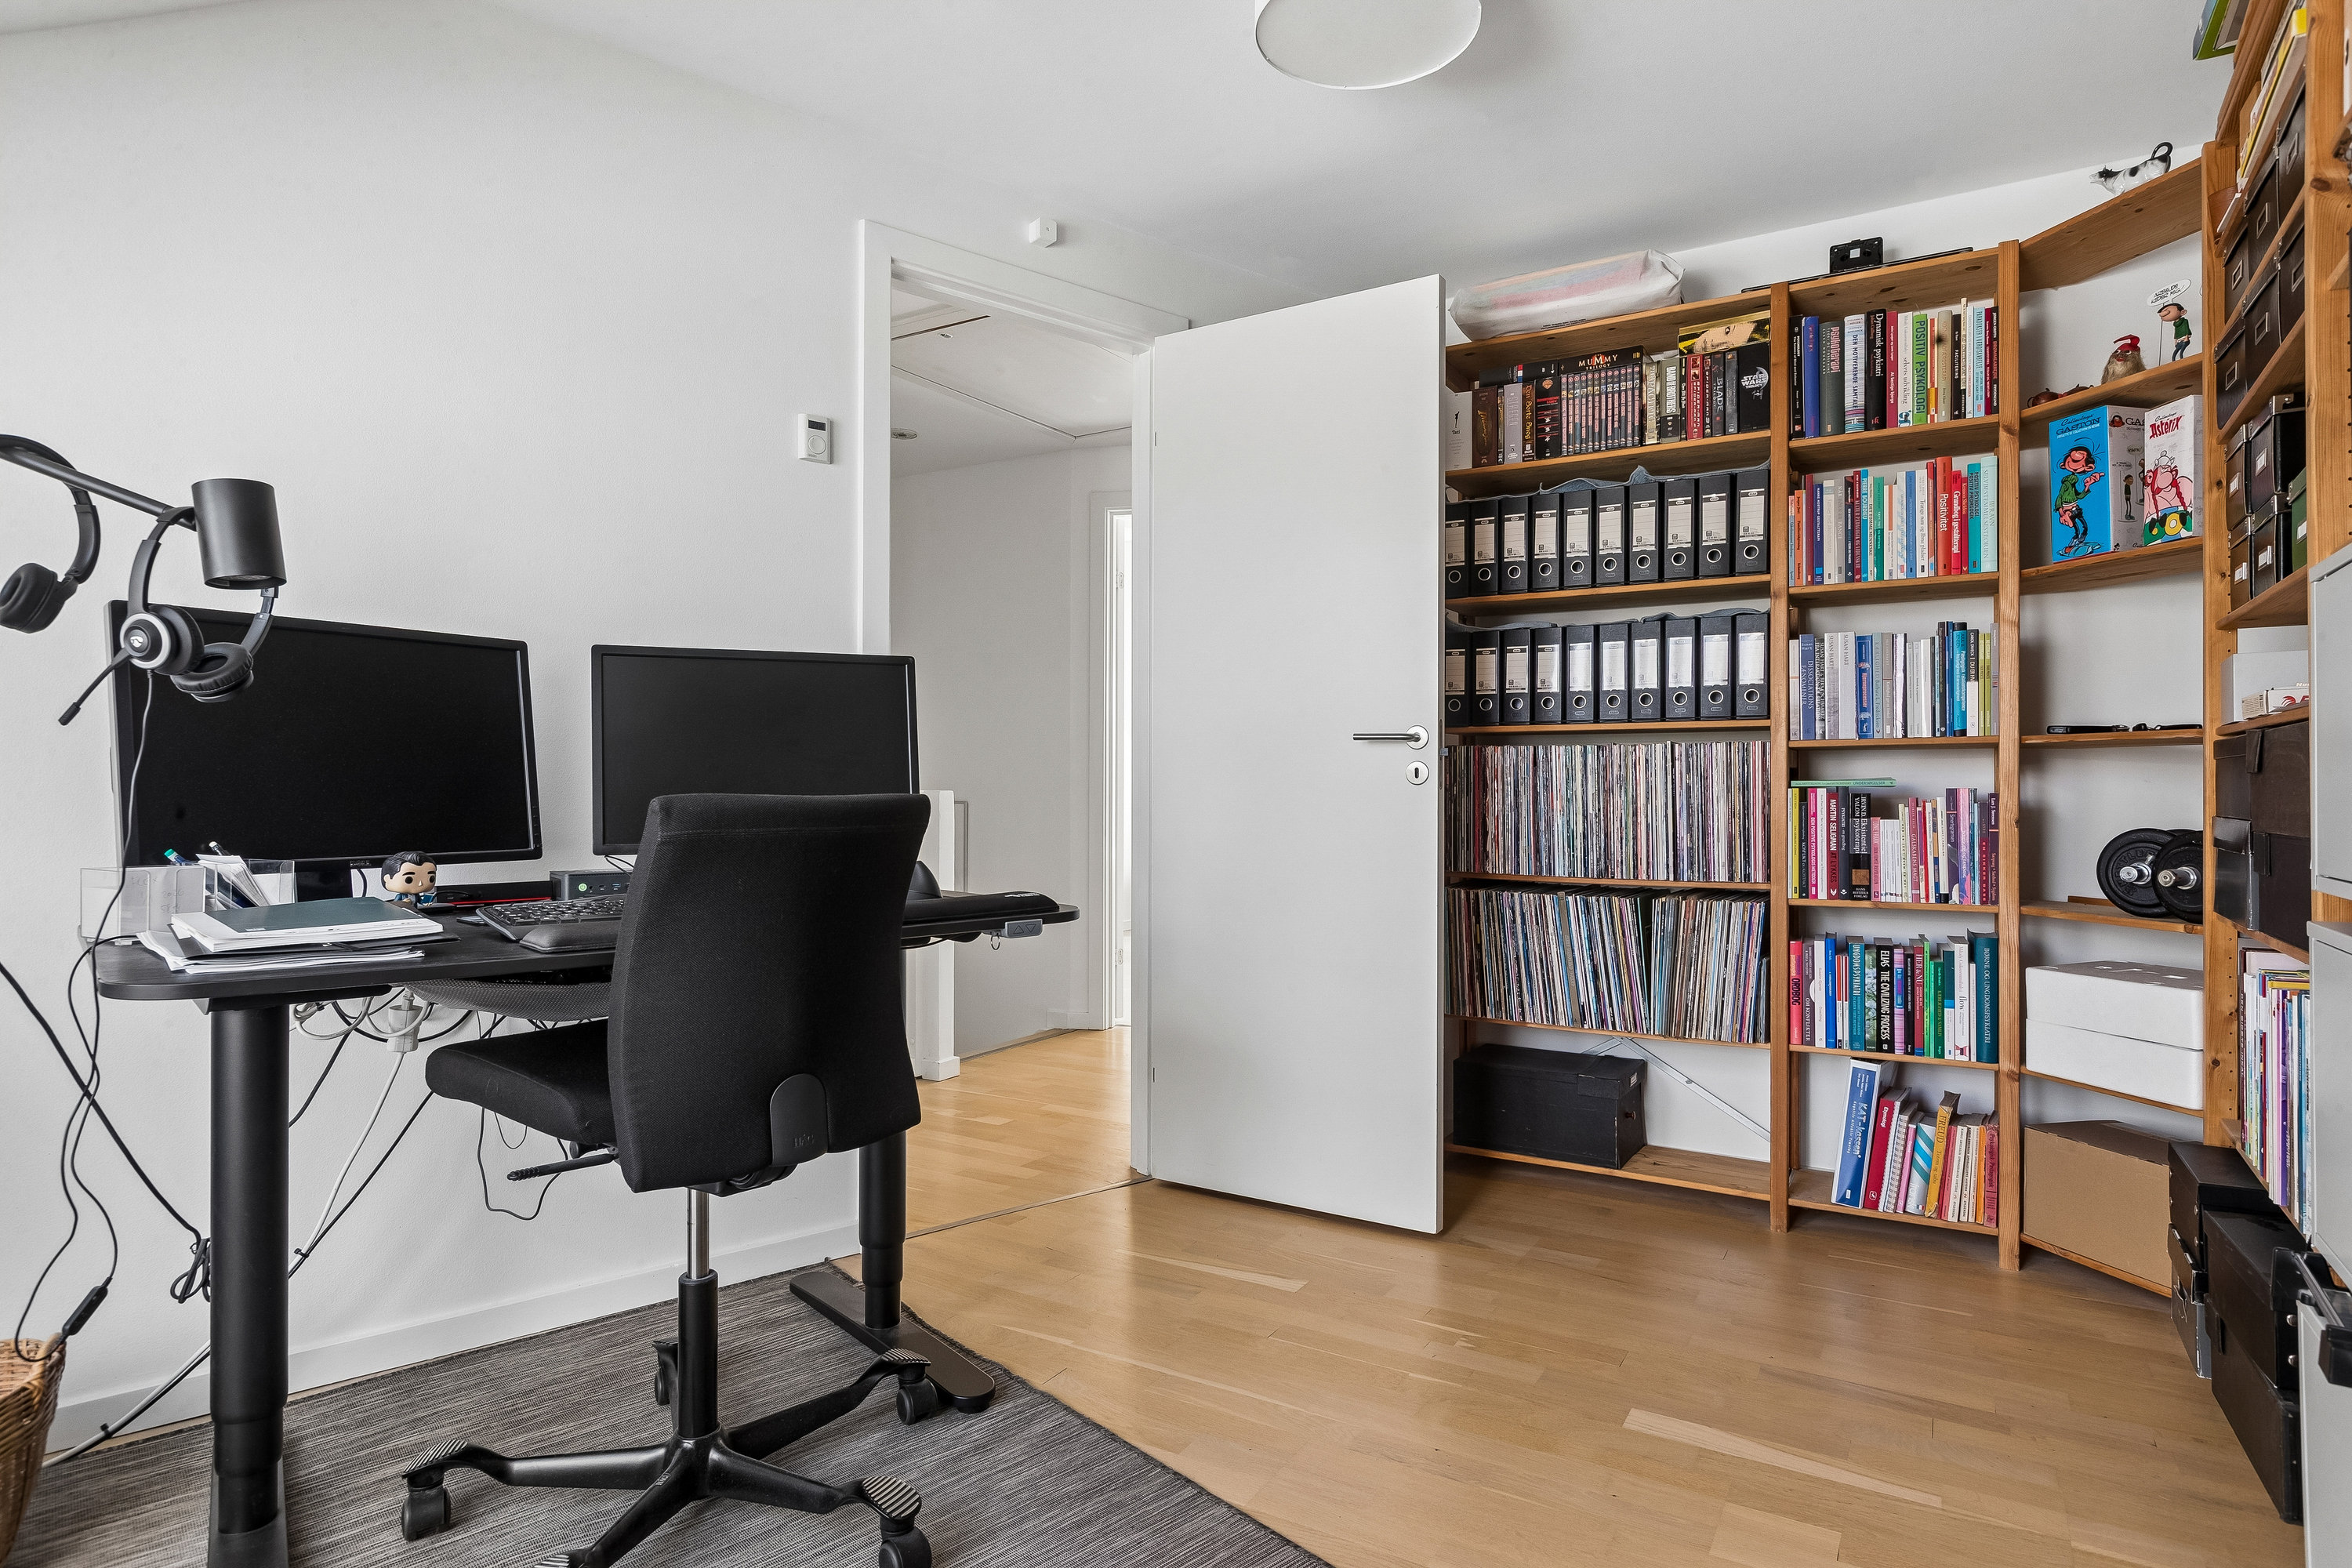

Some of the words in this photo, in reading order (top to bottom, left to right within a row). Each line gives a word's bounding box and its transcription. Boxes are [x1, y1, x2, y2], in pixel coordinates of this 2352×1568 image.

[1874, 314, 1884, 347] Dynamisk
[1915, 320, 1926, 356] POSITIV
[1577, 354, 1618, 368] MUMMY
[1830, 326, 1840, 372] psykoterapi
[1874, 349, 1884, 376] psykiatri
[1666, 366, 1676, 381] BAND
[1666, 386, 1676, 413] BROTHERS
[1915, 361, 1926, 414] PSYKOLOGI
[2056, 417, 2102, 435] GASTON
[1940, 493, 1948, 532] Positivitet
[1952, 491, 1961, 518] Grundbog
[1952, 521, 1961, 554] gestaltterapi
[1982, 842, 1986, 851] EN
[1853, 945, 1861, 996] UNGDOMSPSYKIATRI
[1880, 950, 1890, 967] ELIAS
[1880, 971, 1890, 982] THE
[1915, 975, 1923, 985] NU
[1984, 970, 1991, 980] OG
[1791, 978, 1801, 1005] ORDBOG
[1805, 997, 1811, 1007] OM
[1880, 983, 1890, 1014] CIVILIZING
[1958, 996, 1967, 1010] flow
[1880, 1014, 1890, 1040] PROCESS
[1936, 1114, 1947, 1143] FREUD
